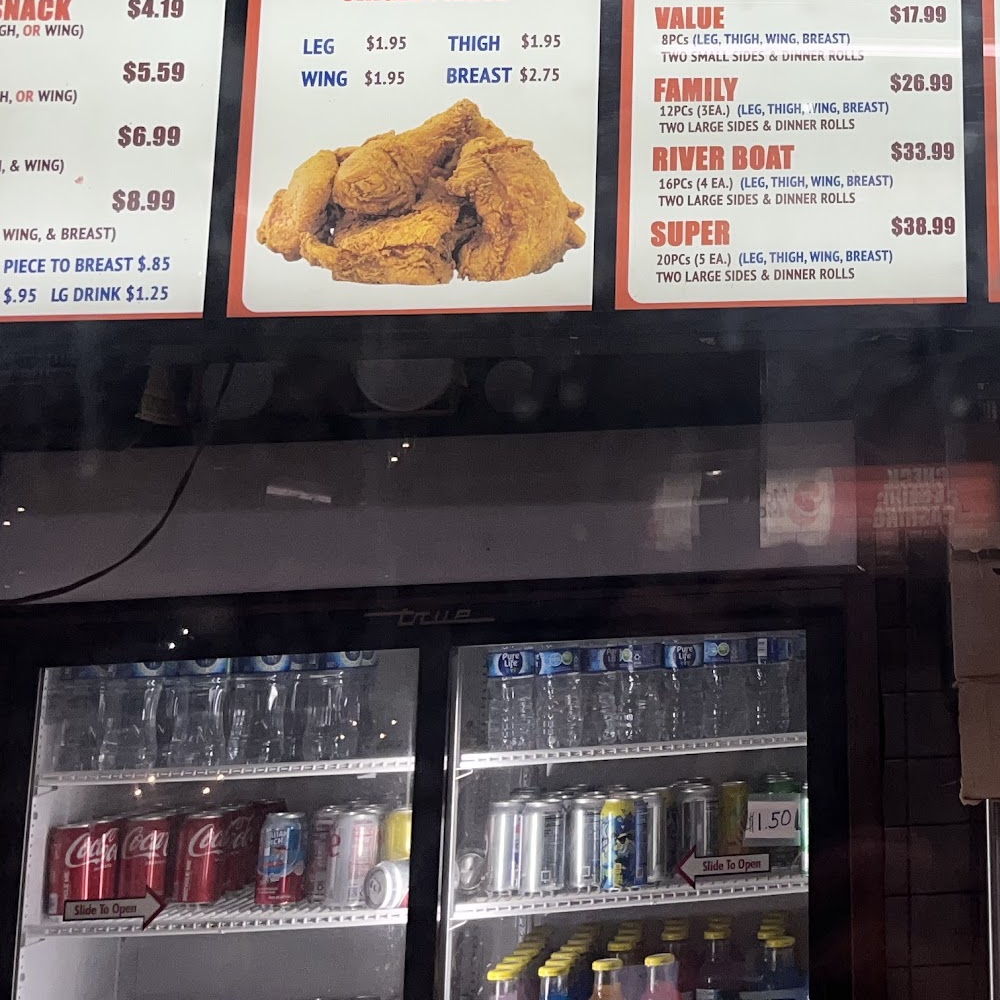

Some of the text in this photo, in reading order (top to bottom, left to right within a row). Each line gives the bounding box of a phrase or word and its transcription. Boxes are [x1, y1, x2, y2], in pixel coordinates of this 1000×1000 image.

[655, 6, 725, 29] VALUE
[890, 4, 946, 24] $17.99
[23, 24, 40, 36] OR
[45, 24, 84, 39] WING)
[303, 38, 334, 55] LEG
[366, 35, 406, 52] $1.95
[448, 35, 500, 51] THIGH
[521, 33, 561, 50] $1.95
[123, 61, 185, 84] $5.59
[301, 70, 347, 87] WING
[365, 70, 405, 87] $1.95
[447, 67, 559, 84] BREAST $2.75
[654, 77, 738, 102] FAMILY
[890, 73, 953, 93] $26.99
[118, 125, 181, 148] $6.99
[652, 145, 795, 172] RIVER BOAT
[891, 141, 955, 162] $33.99
[112, 189, 175, 213] $8.99
[651, 220, 730, 247] SUPER
[891, 216, 955, 237] $38.99
[4, 255, 170, 274] PIECE TO BREAST $.85
[657, 250, 893, 267] 20PCs (5 EA.) (LEG, THIGH, WING, BREAST)
[3, 285, 168, 304] $.95 LG DRINK $1.25
[501, 652, 520, 661] Pure
[504, 659, 518, 668] Life
[702, 858, 762, 872] Slide To Open
[74, 903, 137, 918] Slide To Open
